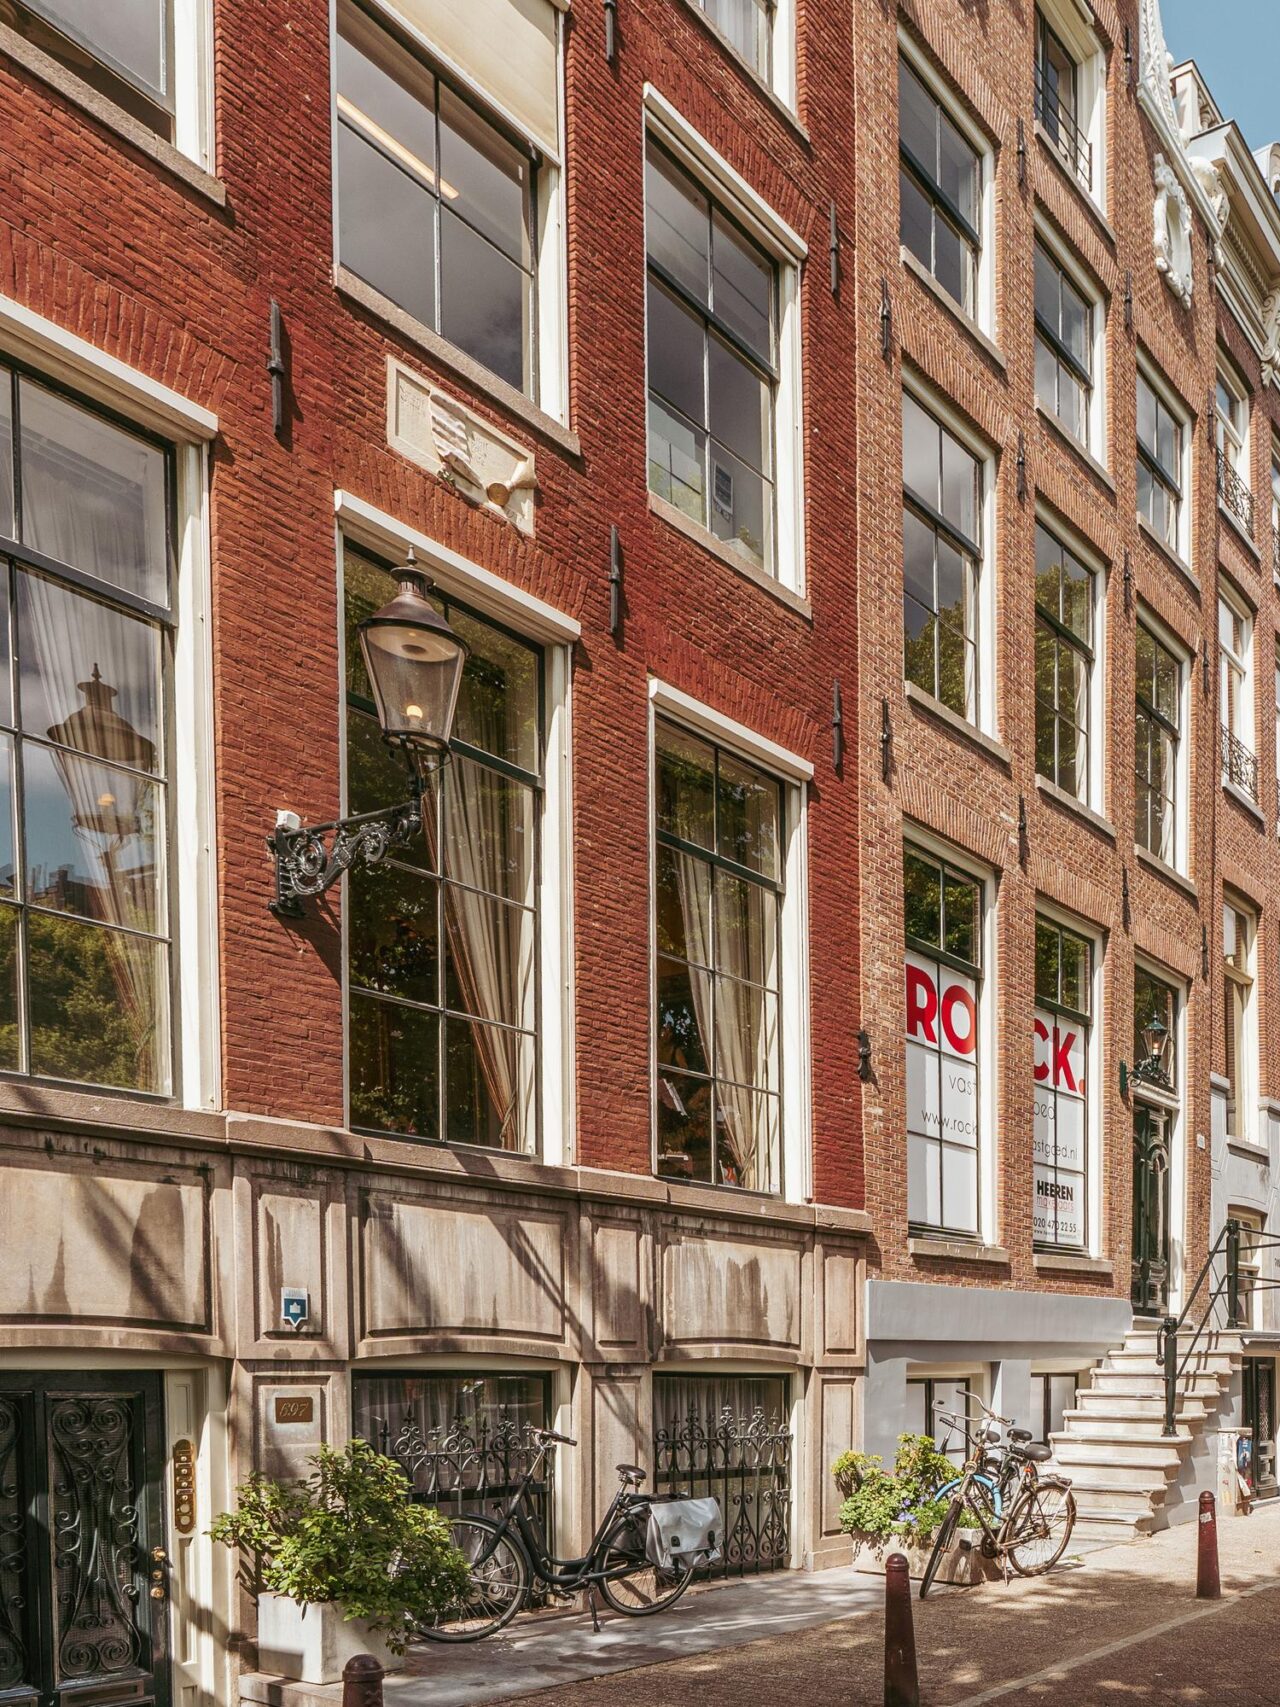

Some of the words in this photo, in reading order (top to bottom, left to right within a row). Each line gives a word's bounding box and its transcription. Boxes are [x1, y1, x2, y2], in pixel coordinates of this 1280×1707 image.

[906, 963, 976, 1055] RO
[1037, 1180, 1074, 1201] HEEREN
[1033, 1216, 1046, 1228] 020
